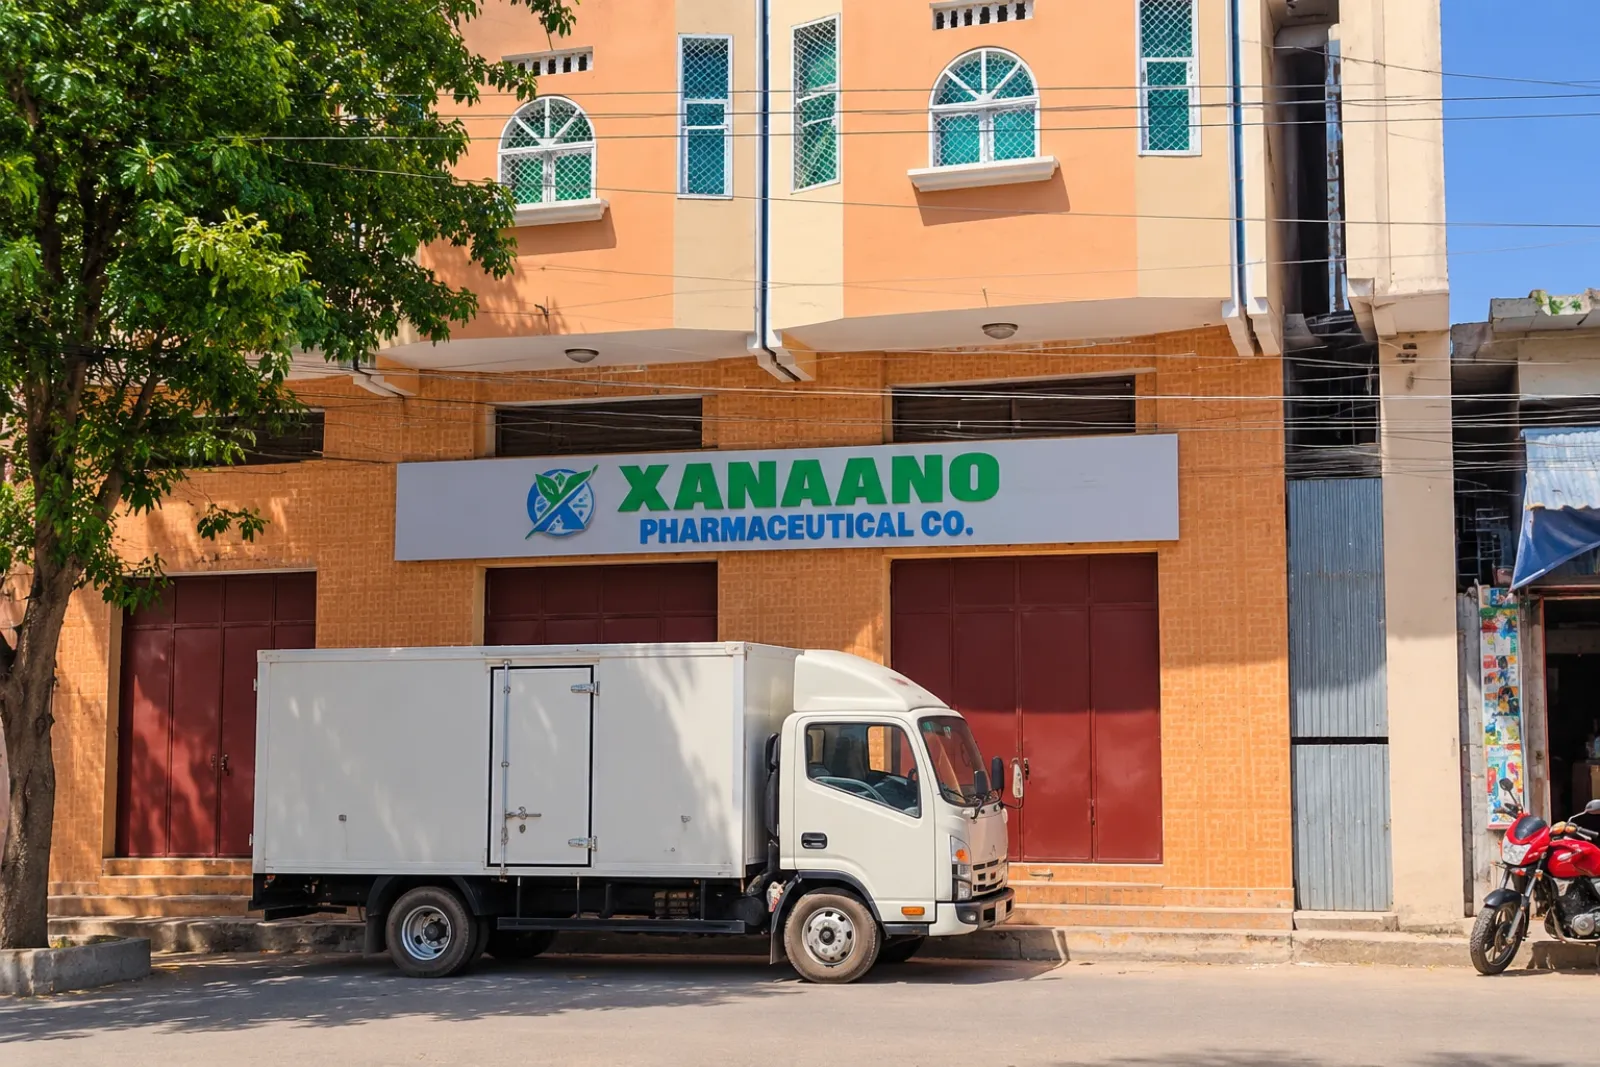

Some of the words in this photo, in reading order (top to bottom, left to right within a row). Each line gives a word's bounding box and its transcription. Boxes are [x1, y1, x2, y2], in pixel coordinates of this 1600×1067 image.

[618, 452, 1000, 513] XANAANO
[639, 511, 915, 545] PHARMACEUTICAL
[920, 509, 974, 537] CO.
